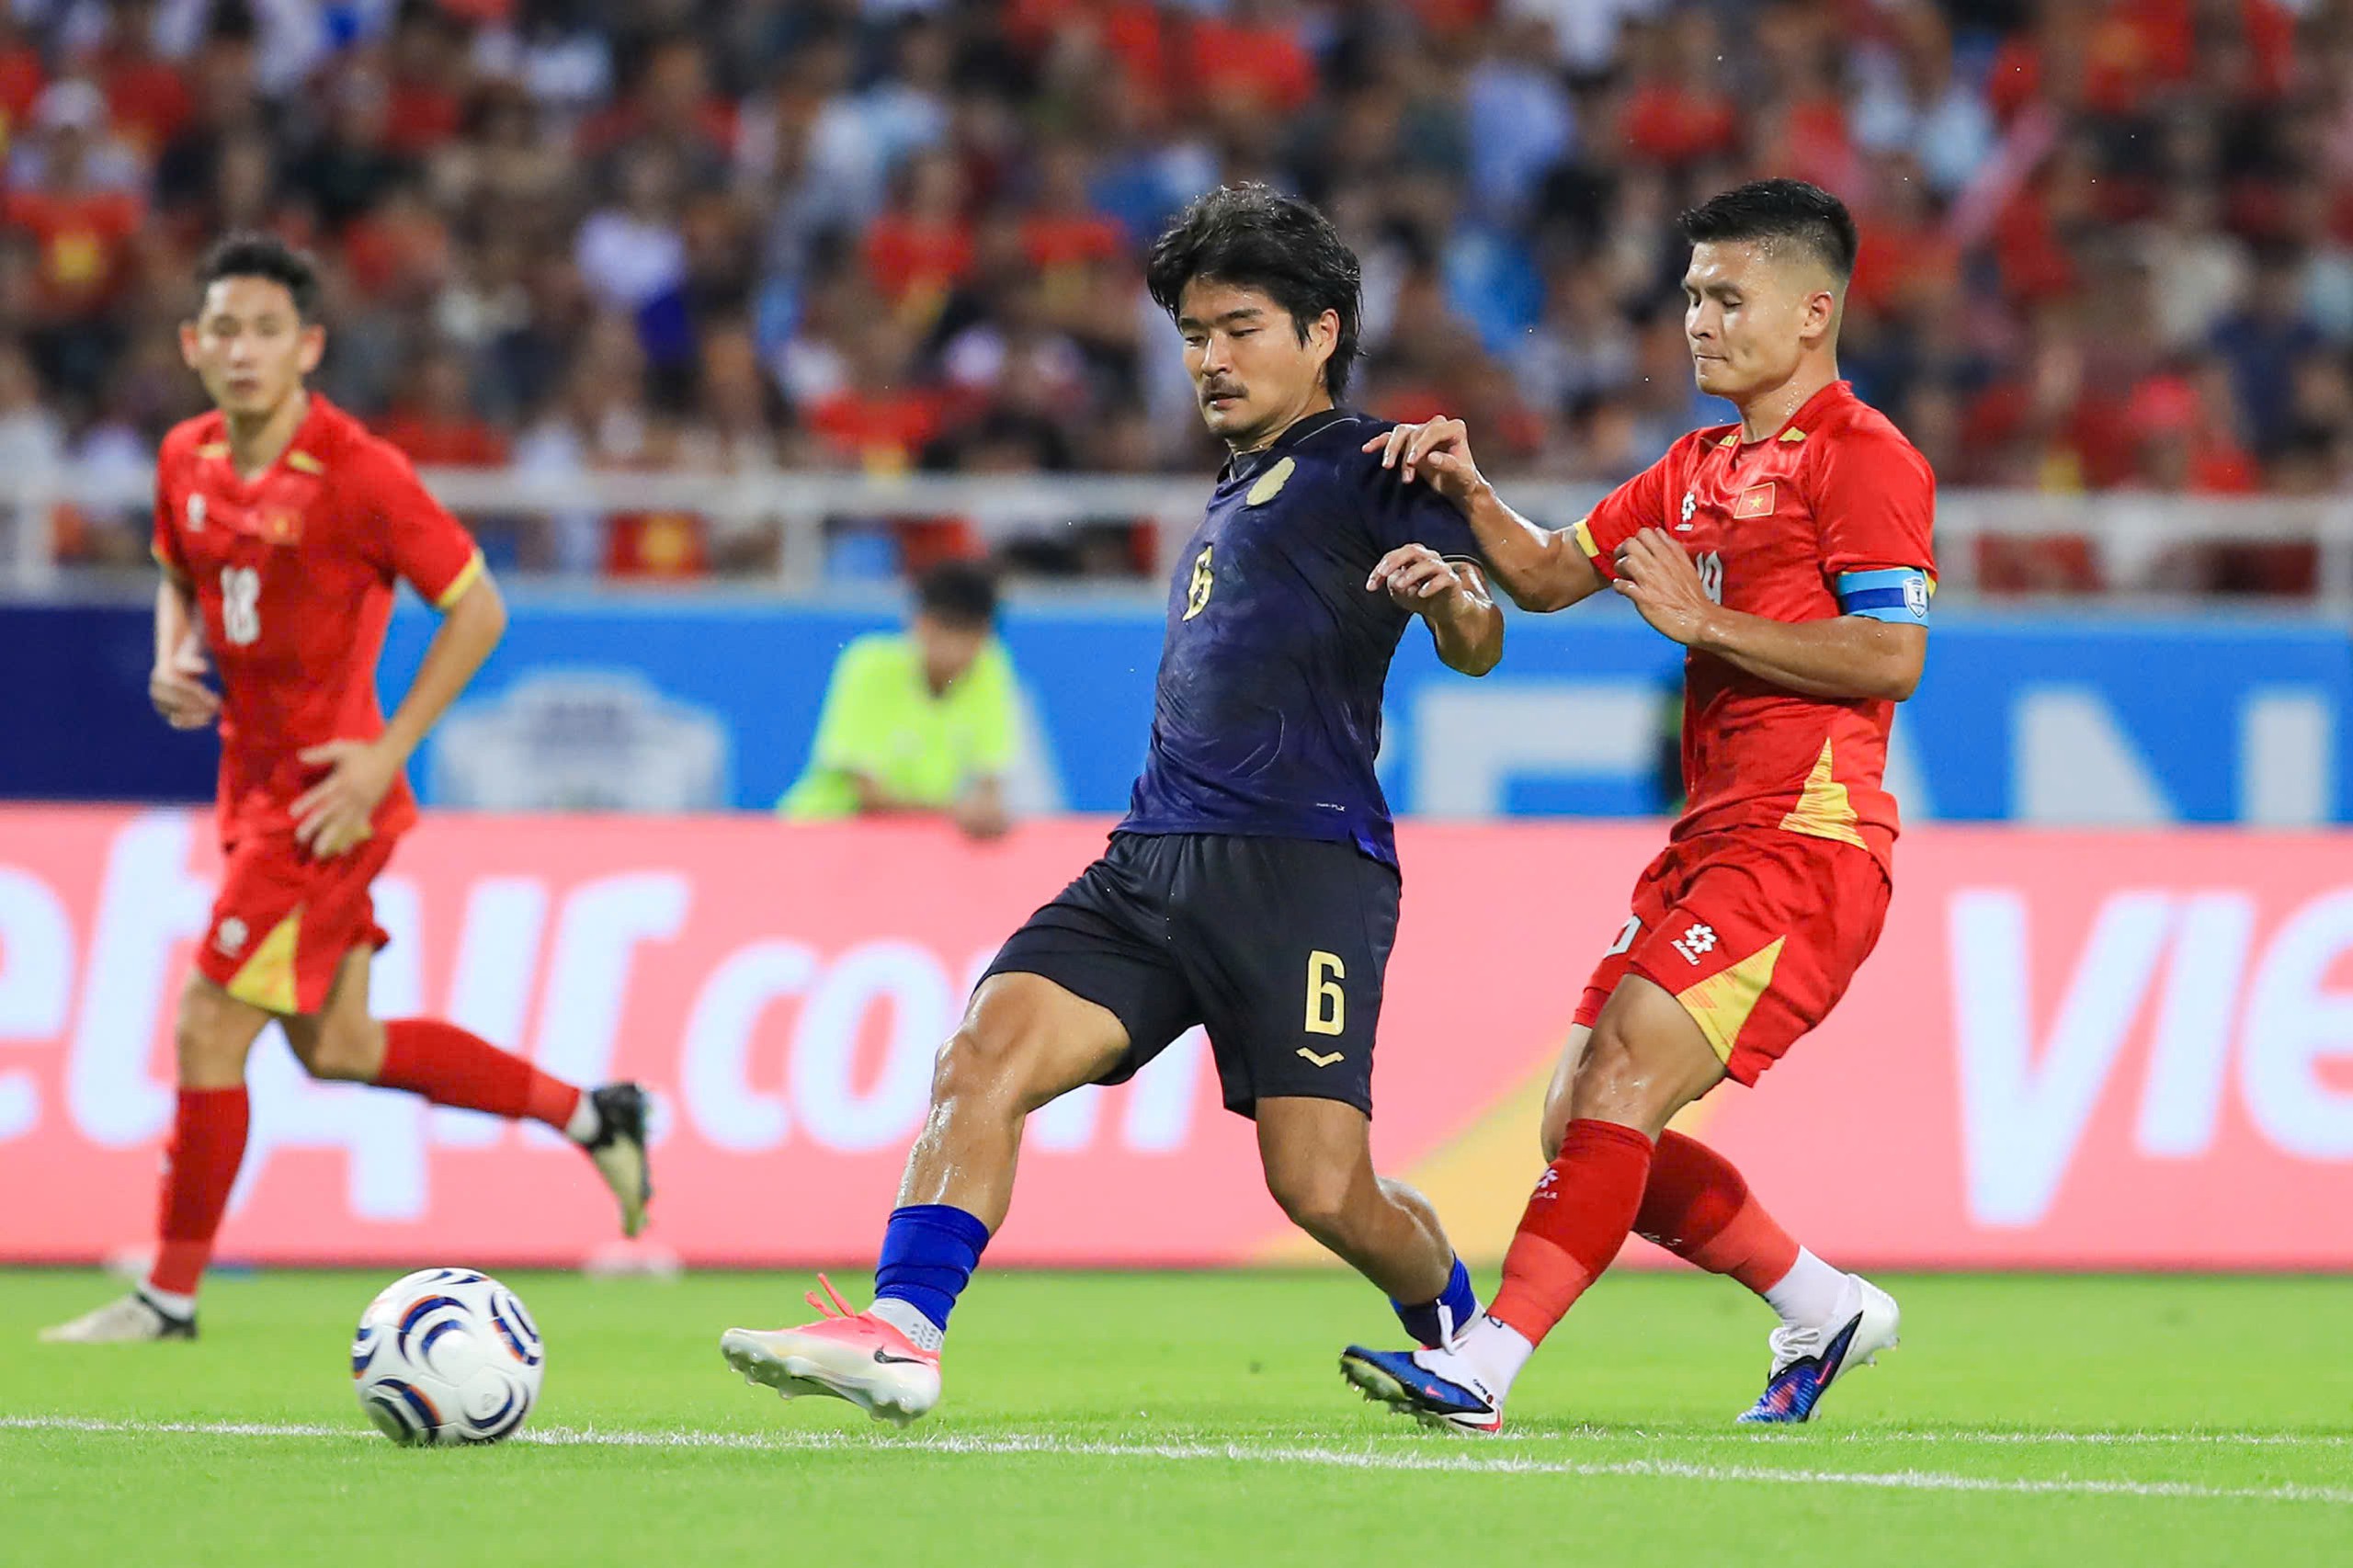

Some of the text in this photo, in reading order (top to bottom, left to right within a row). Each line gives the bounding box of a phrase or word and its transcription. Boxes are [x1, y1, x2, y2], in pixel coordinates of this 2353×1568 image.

[221, 566, 260, 644] 18
[1182, 545, 1213, 620] 6
[1305, 950, 1346, 1036] 6
